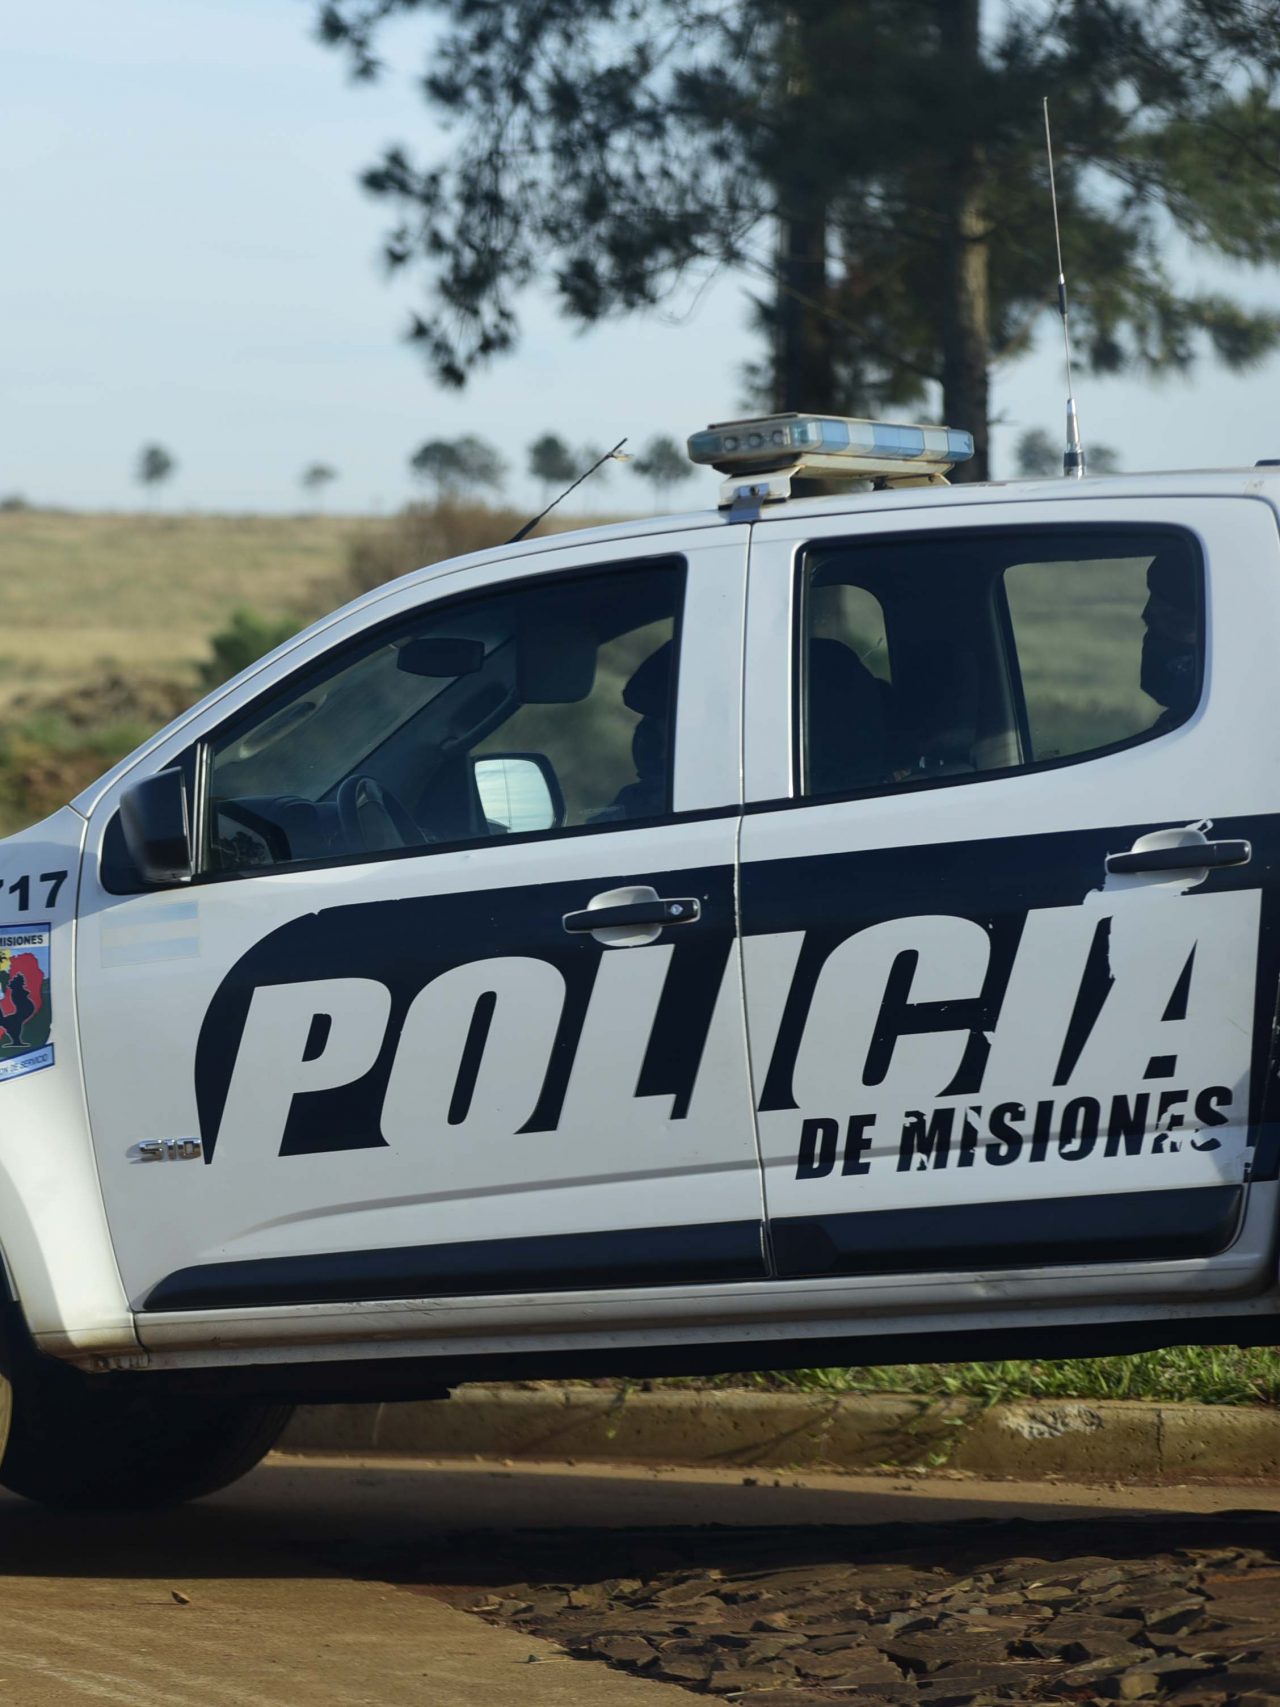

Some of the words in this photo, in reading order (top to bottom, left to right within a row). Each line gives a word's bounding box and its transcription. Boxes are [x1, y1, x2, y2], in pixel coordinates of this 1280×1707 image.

[210, 887, 1263, 1166] POLICIA
[138, 1137, 202, 1162] S10
[795, 1114, 877, 1180] DE
[896, 1085, 1234, 1173] MISIONES
